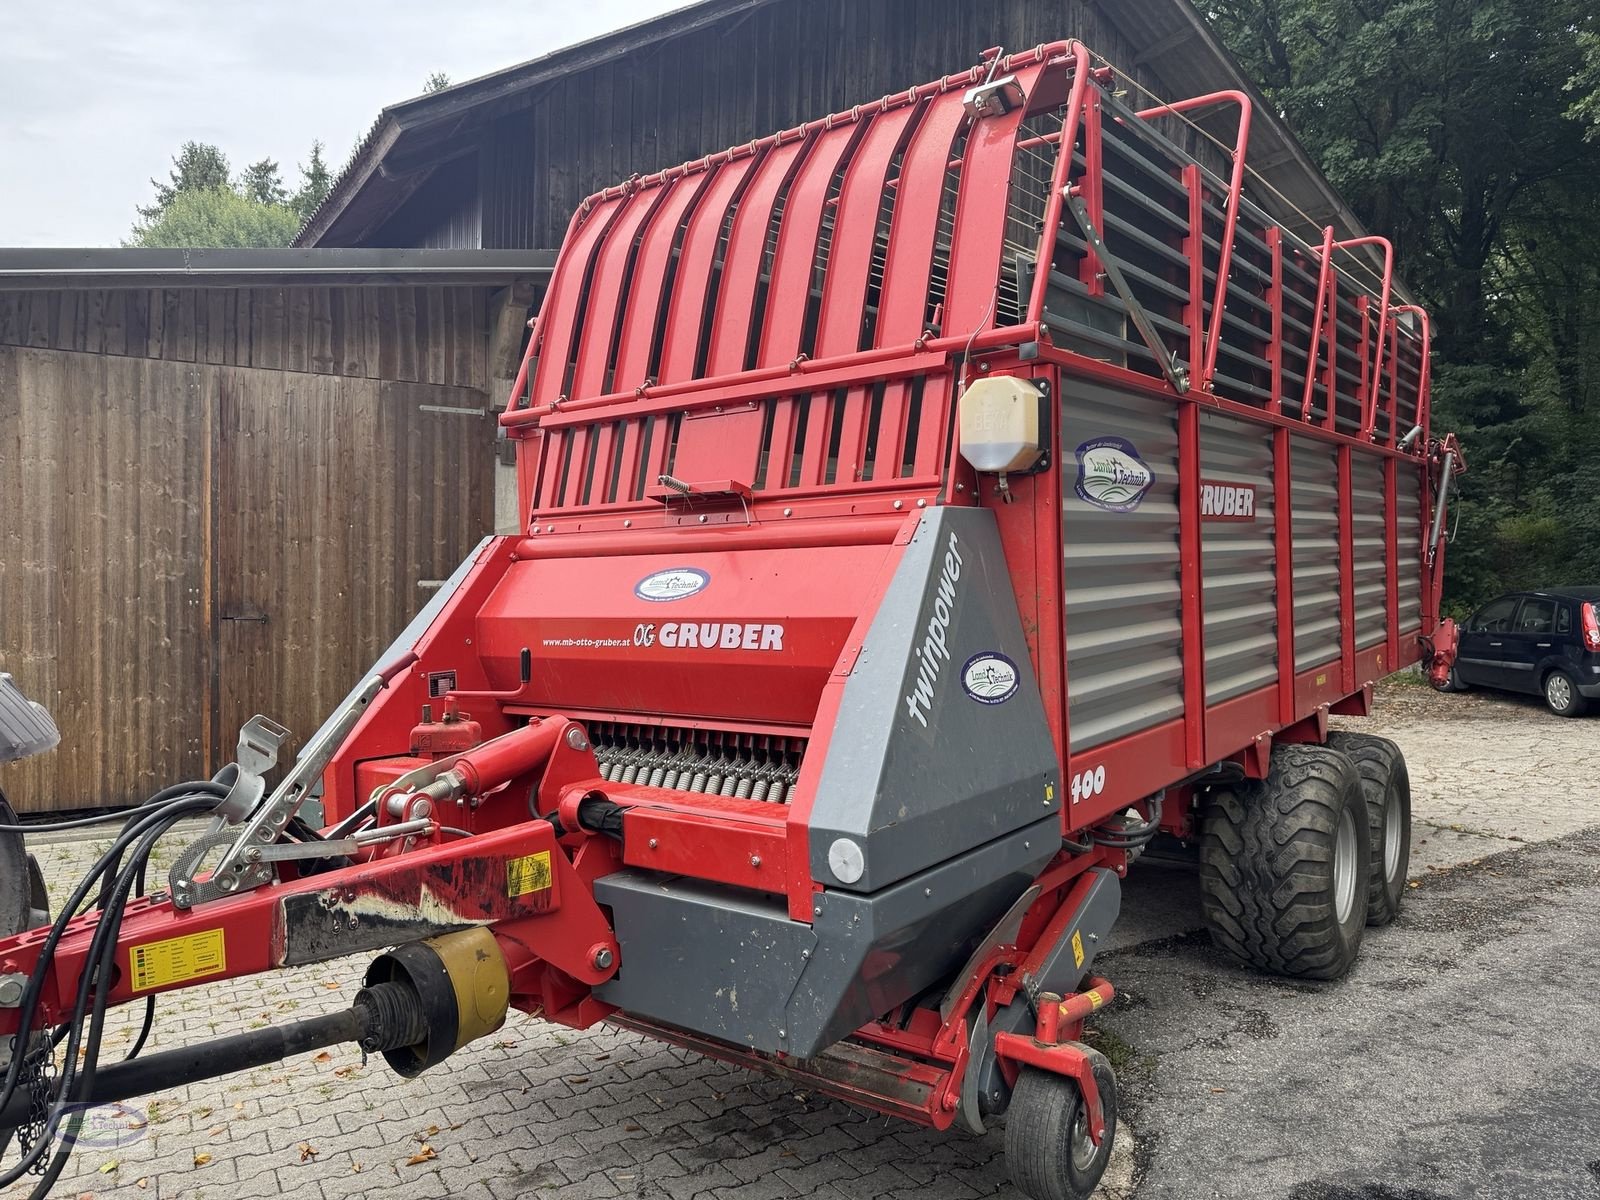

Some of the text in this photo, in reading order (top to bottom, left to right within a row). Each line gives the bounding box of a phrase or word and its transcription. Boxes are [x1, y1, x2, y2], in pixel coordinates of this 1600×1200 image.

[1089, 457, 1113, 474] Land
[1117, 469, 1147, 487] Technik
[1200, 485, 1254, 517] RUBER
[542, 637, 631, 649] www.mb-otto-gruber.at
[659, 622, 785, 650] GRUBER
[906, 531, 963, 728] twinpower
[1071, 765, 1106, 805] 400
